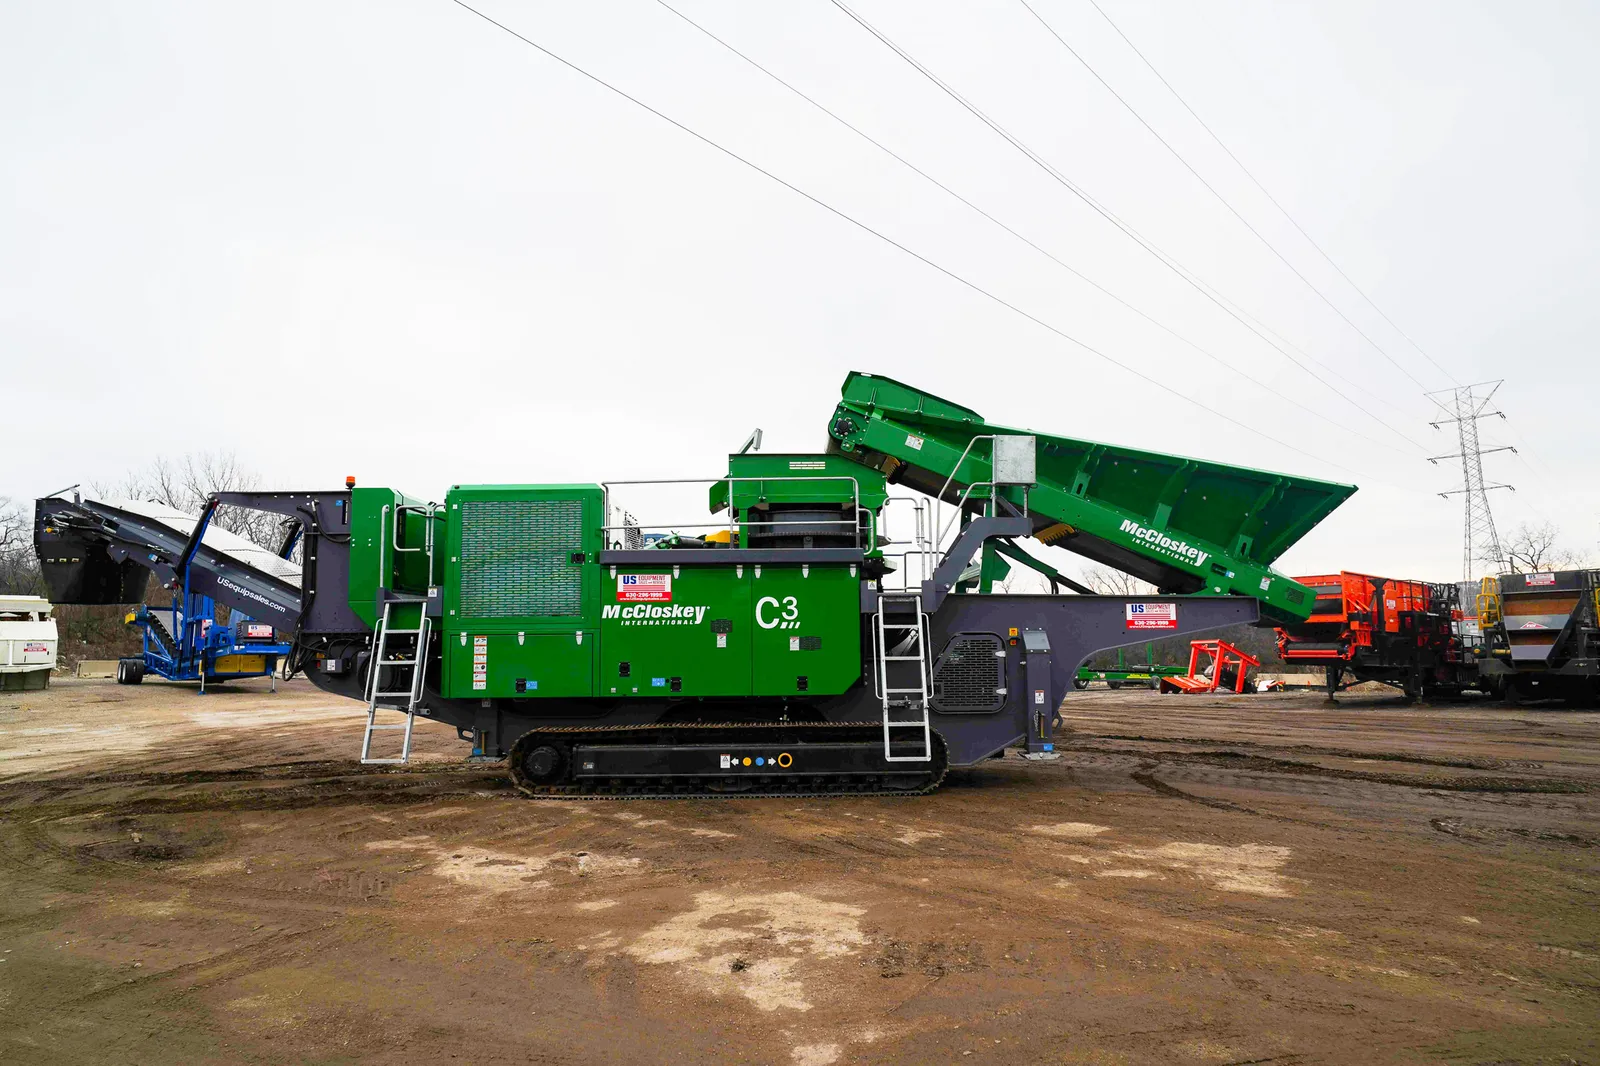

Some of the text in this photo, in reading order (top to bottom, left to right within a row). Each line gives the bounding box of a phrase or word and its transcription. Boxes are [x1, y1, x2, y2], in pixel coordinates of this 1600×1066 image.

[1120, 519, 1208, 567] McCloskey
[1132, 537, 1194, 565] INTERNATIONAL
[623, 575, 637, 585] US
[217, 576, 286, 613] USequipsales.com
[1131, 604, 1145, 613] US
[601, 604, 706, 625] McCloskey
[755, 596, 799, 629] C3
